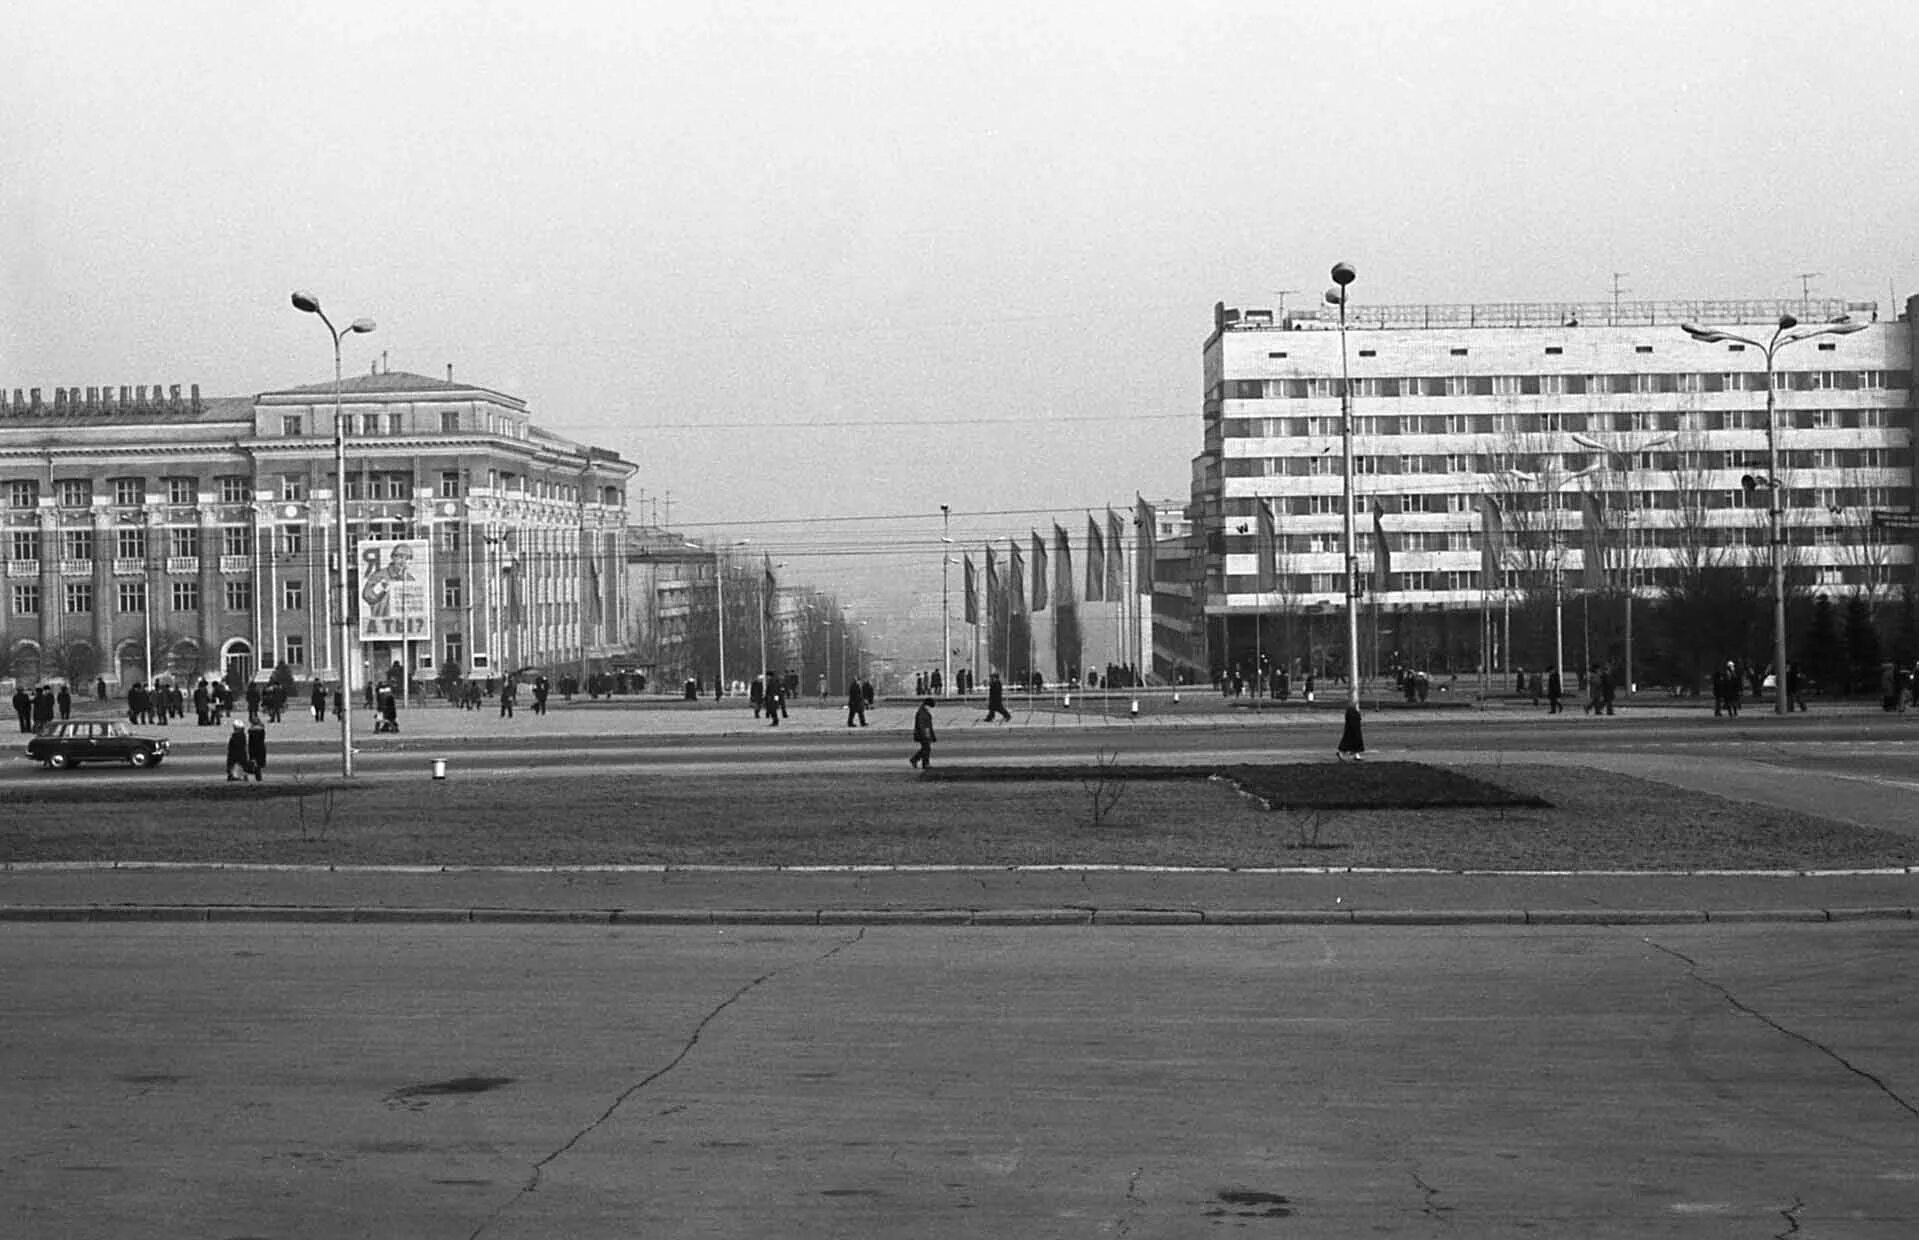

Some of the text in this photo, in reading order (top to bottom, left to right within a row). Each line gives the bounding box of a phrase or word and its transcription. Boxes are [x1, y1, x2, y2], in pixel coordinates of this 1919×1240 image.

[362, 547, 381, 578] Я
[367, 619, 424, 633] А ТЫ?
